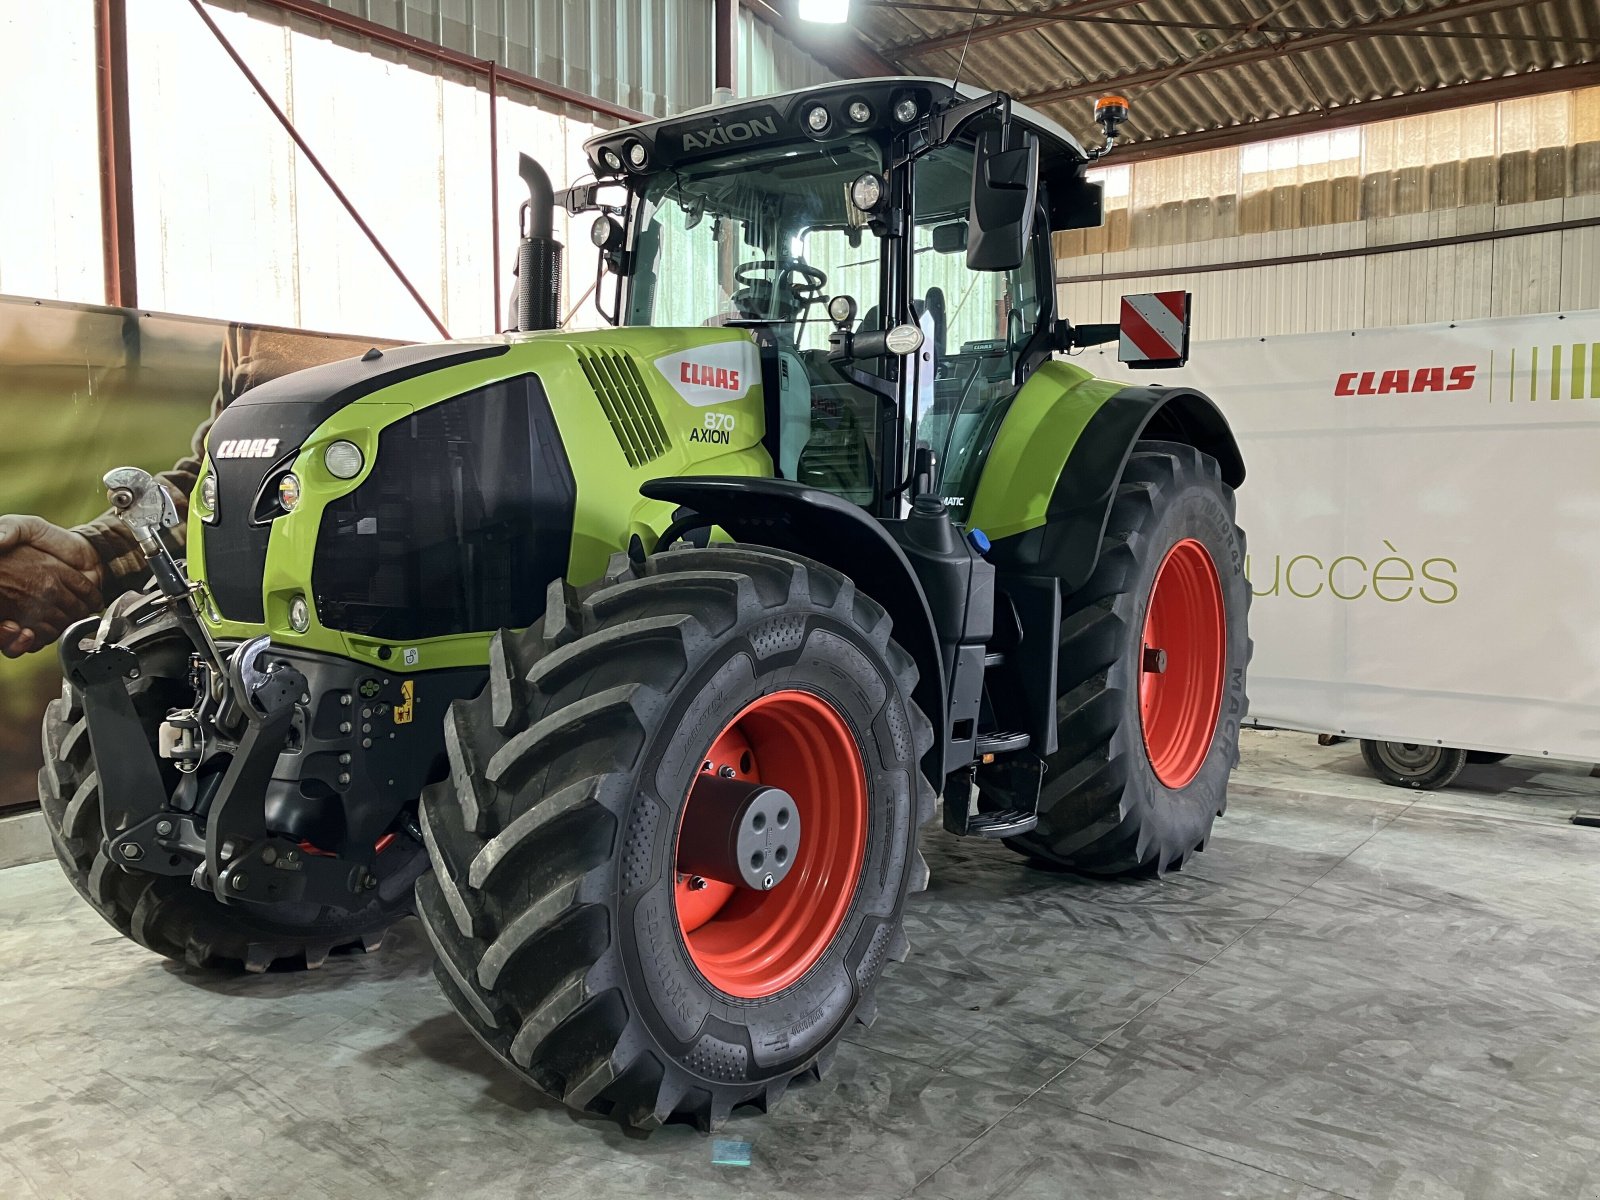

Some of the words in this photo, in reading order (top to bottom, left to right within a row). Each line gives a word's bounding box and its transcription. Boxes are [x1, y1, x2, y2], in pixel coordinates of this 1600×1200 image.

[683, 116, 777, 152] AXION
[681, 362, 739, 391] CLAAS
[1334, 365, 1476, 396] CLAAS
[704, 412, 735, 432] 870
[216, 438, 280, 459] CLAAS
[689, 428, 730, 444] AXION
